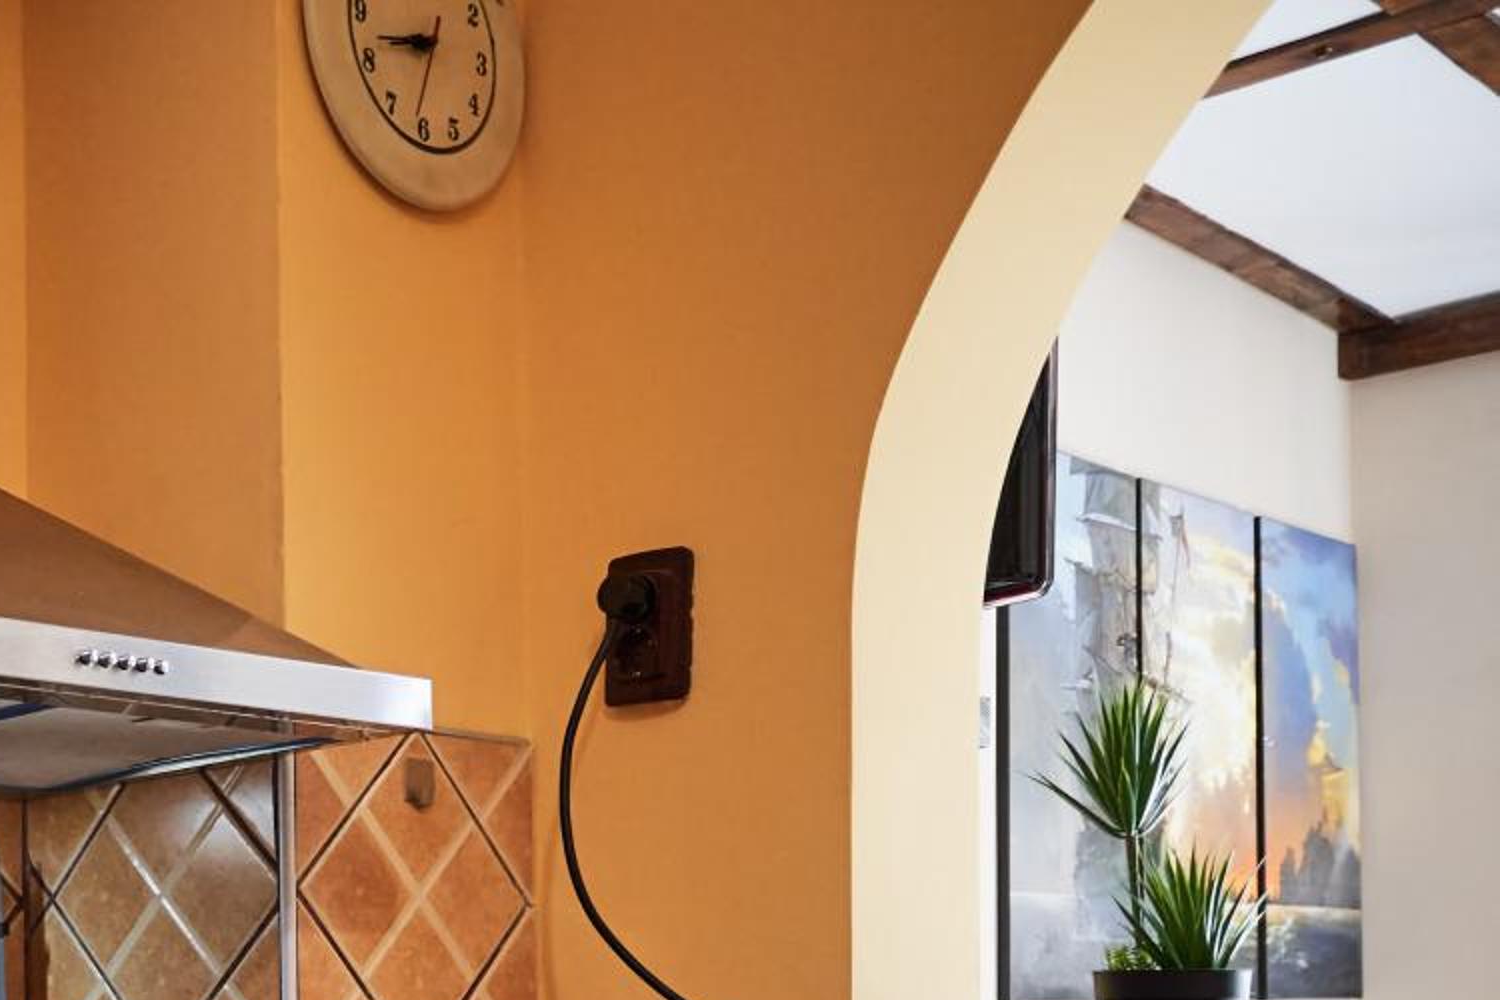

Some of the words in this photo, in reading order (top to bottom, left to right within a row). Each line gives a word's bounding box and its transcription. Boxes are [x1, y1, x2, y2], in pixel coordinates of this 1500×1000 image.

[355, 0, 366, 22] 9
[468, 4, 479, 27] 2
[363, 48, 375, 73] 8
[476, 52, 487, 76] 3
[386, 91, 397, 115] 7
[468, 93, 480, 117] 4
[417, 118, 430, 142] 6
[448, 118, 459, 141] 5
